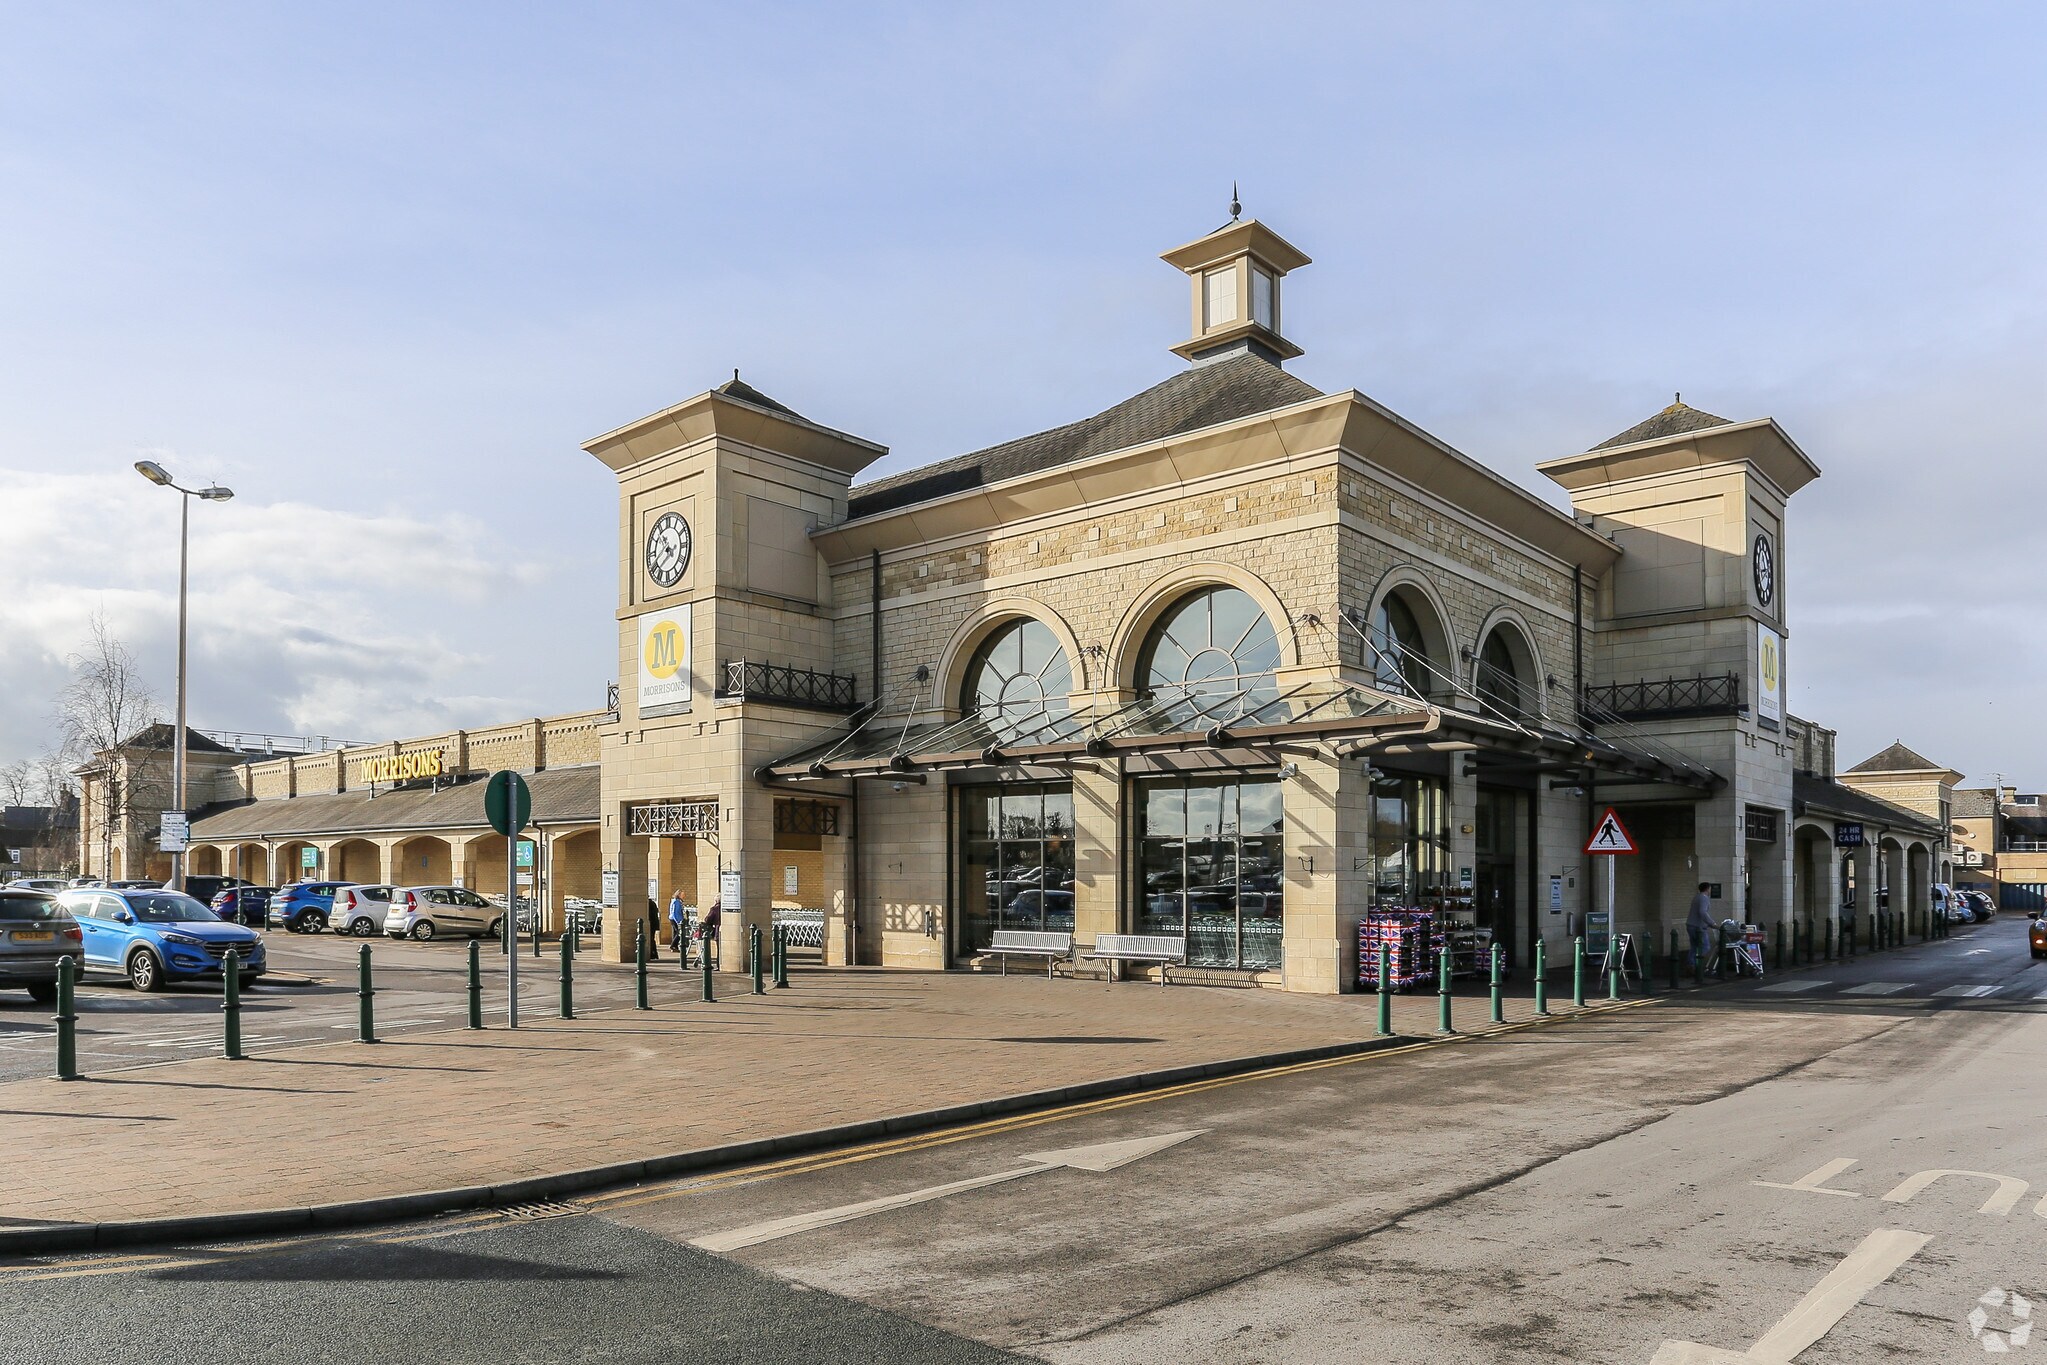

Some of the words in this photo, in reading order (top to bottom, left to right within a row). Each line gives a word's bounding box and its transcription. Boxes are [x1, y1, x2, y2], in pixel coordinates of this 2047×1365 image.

[652, 629, 676, 669] M
[1764, 643, 1775, 682] M
[643, 680, 686, 697] MORRISONS
[360, 749, 443, 783] MORRISONS
[1838, 826, 1847, 834] 24
[1849, 826, 1860, 834] HR
[1838, 834, 1861, 842] CASH
[1751, 1157, 2047, 1219] UT
